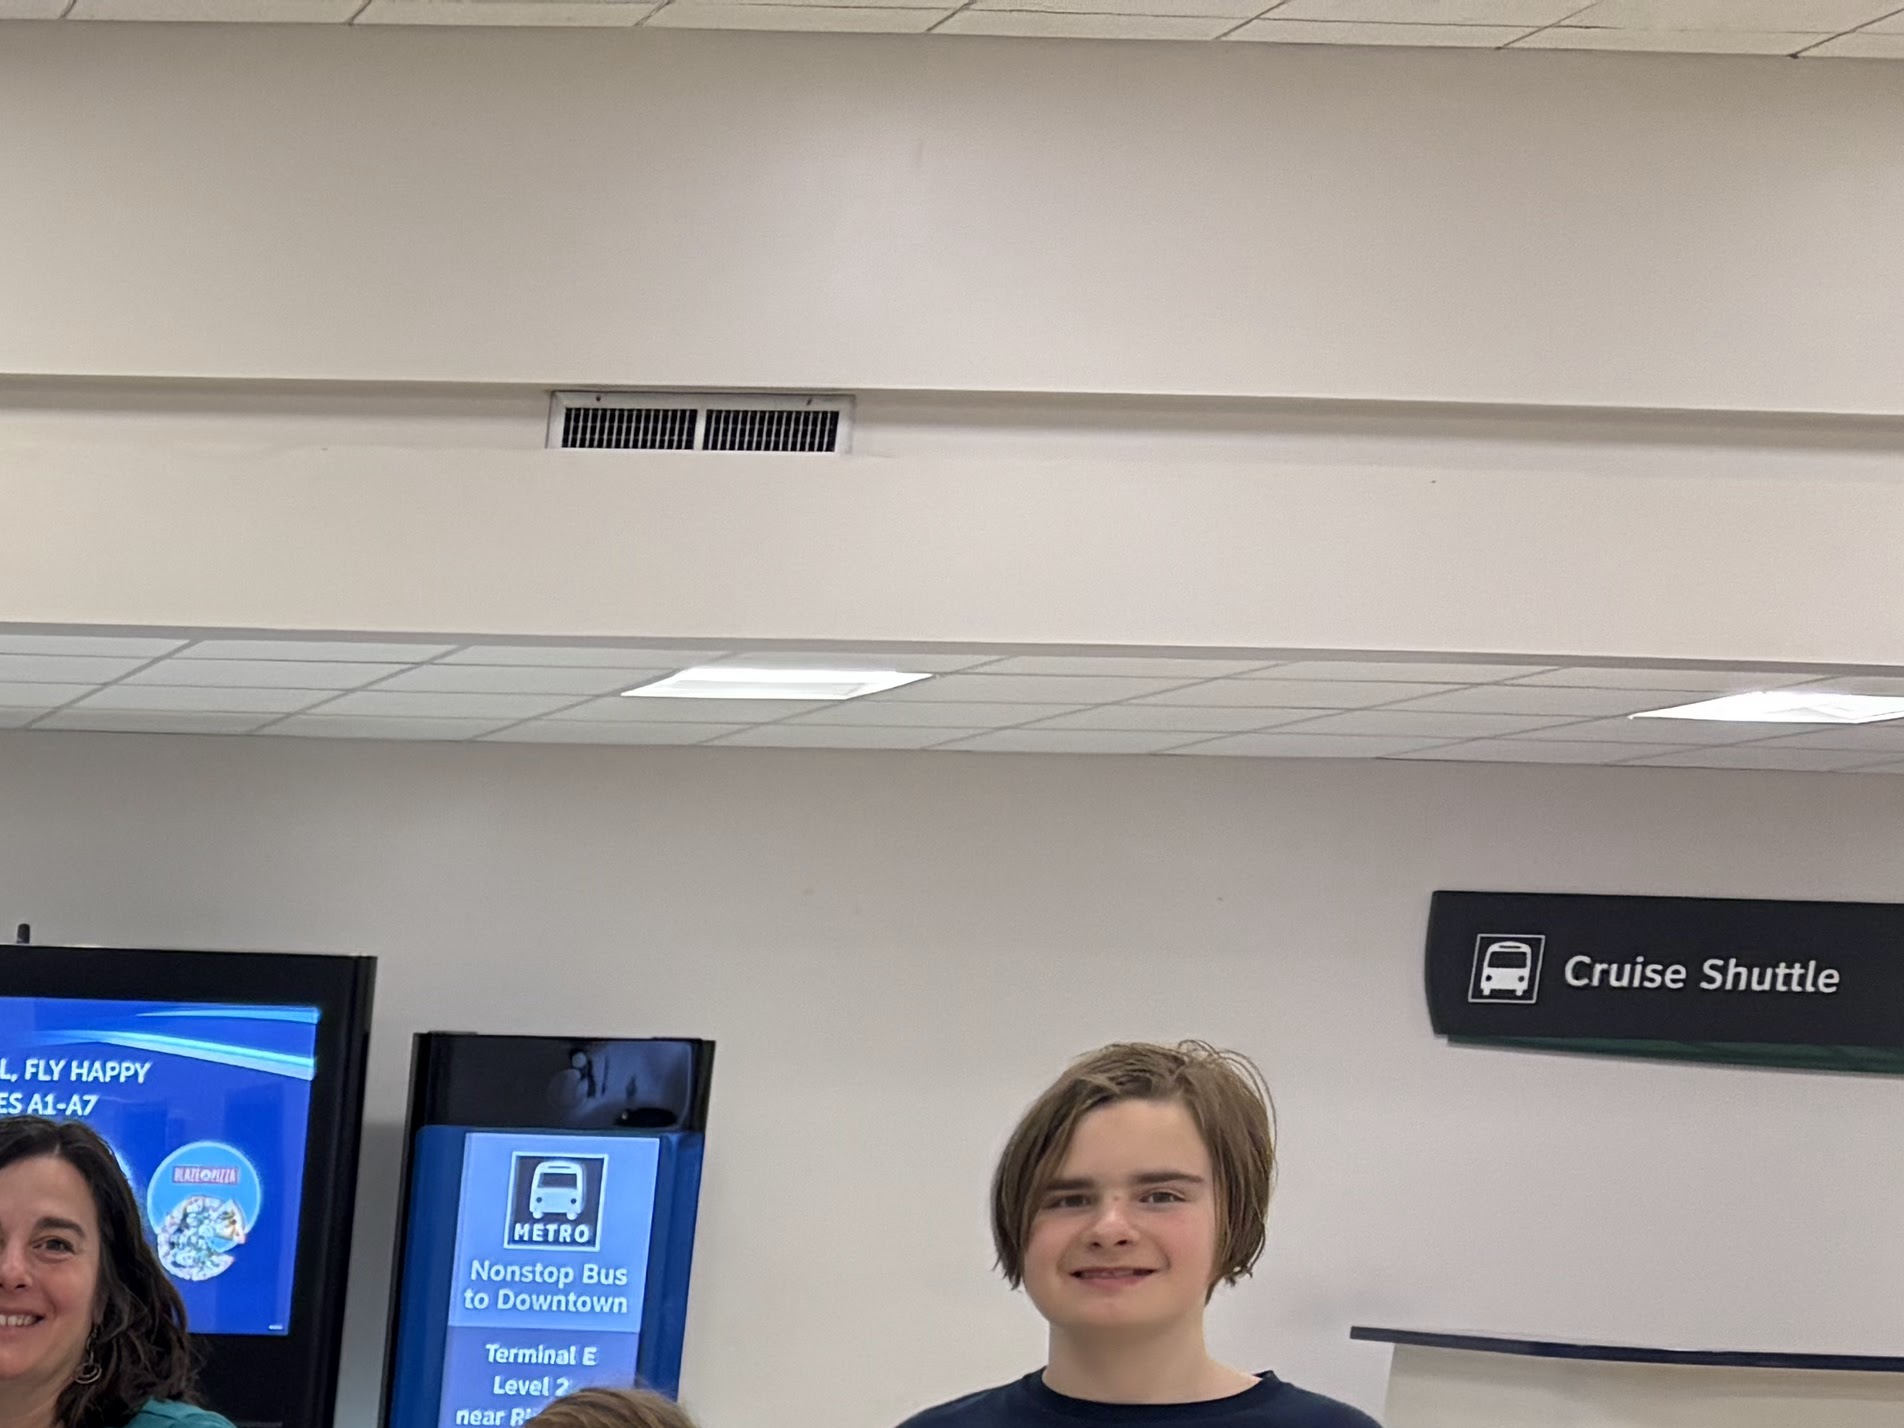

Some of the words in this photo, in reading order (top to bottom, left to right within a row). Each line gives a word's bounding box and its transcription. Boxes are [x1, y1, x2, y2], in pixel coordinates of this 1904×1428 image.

[1565, 955, 1687, 989] Cruise
[1700, 958, 1840, 993] Shuttle
[25, 1058, 66, 1081] FLY
[70, 1060, 152, 1083] HAPPY
[27, 1093, 100, 1116] A1-A7
[514, 1223, 589, 1243] METRO
[471, 1259, 574, 1289] Nonstop
[582, 1263, 628, 1285] Bus
[464, 1288, 489, 1309] to
[497, 1288, 628, 1313] Downtown
[486, 1343, 576, 1365] Terminal
[582, 1347, 597, 1366] E
[493, 1375, 549, 1396] Level
[555, 1377, 569, 1396] 2
[456, 1409, 506, 1426] near
